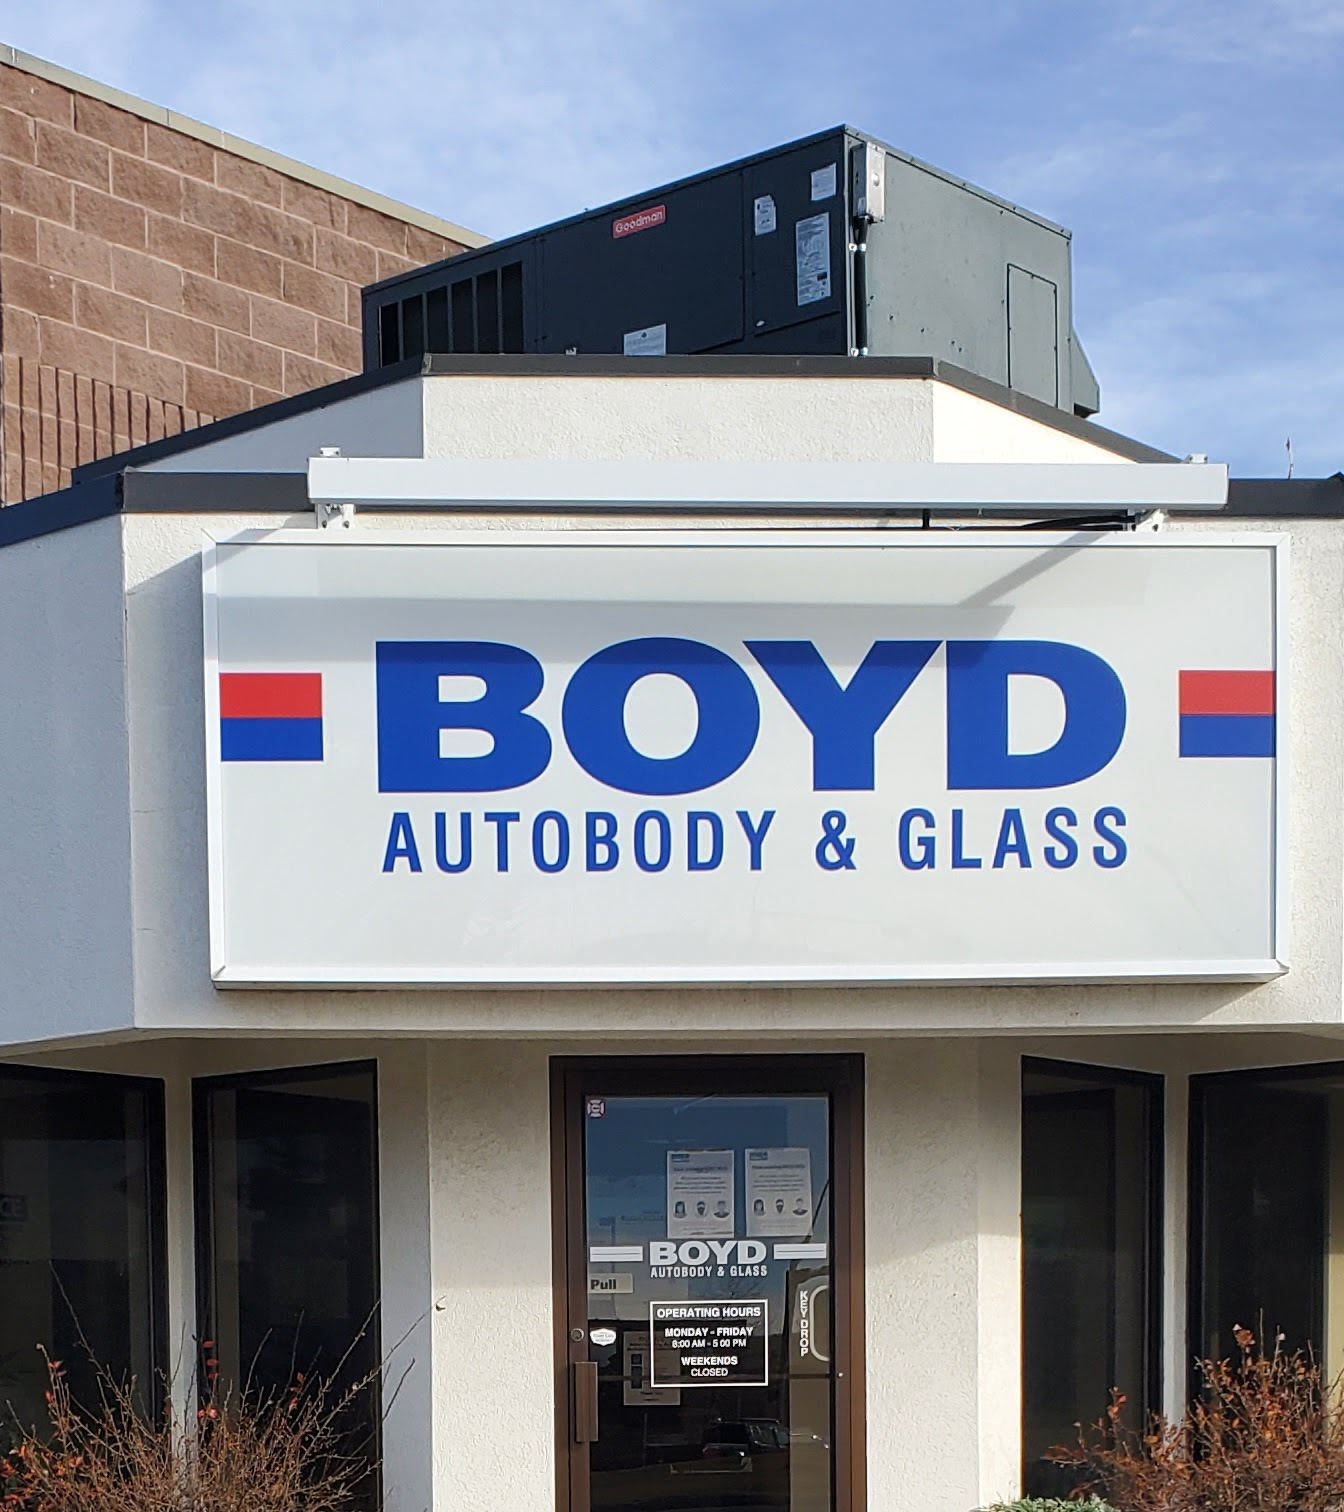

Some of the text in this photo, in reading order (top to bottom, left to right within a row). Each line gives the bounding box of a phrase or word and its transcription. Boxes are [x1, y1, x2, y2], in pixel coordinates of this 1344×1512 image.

[615, 211, 663, 233] Goodman
[375, 636, 1127, 797] BOYD
[382, 807, 1129, 874] AUTOBODY & GLASS
[649, 1240, 767, 1265] BOYD
[650, 1265, 768, 1278] AUTOBODY & GLASS
[590, 1279, 617, 1291] Pull
[656, 1306, 761, 1318] OPERATING HOURS
[799, 1290, 809, 1357] KEY DROP
[664, 1327, 709, 1337] MONDAY
[716, 1326, 754, 1336] FRIDAY
[691, 1339, 706, 1347] AM
[732, 1338, 747, 1347] PM
[680, 1356, 739, 1366] WEEKENDS
[690, 1368, 729, 1377] CLOSED
